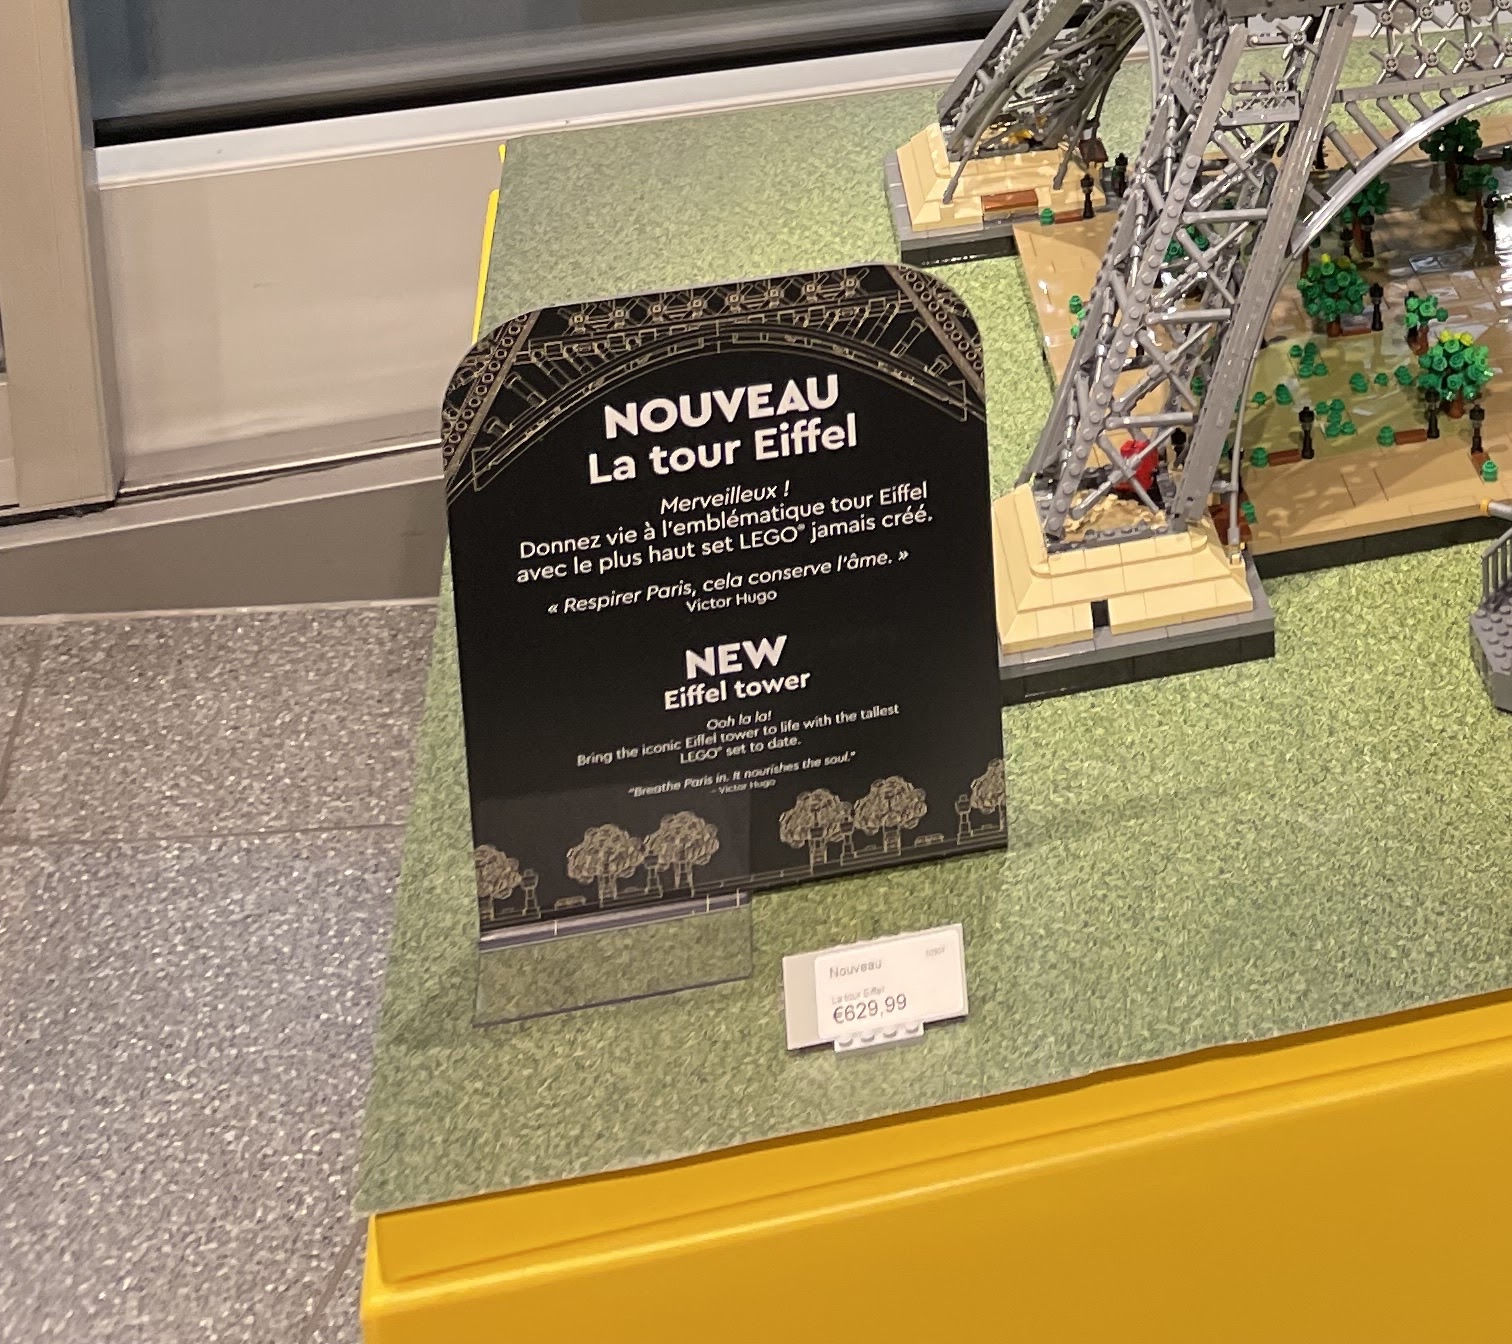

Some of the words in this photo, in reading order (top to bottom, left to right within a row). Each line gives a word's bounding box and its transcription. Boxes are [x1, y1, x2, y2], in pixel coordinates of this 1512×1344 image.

[604, 373, 839, 440] NOUVEAU
[588, 453, 637, 485] La
[649, 439, 742, 475] tour
[754, 412, 858, 461] Eiffel
[660, 484, 778, 515] Merveilleux
[520, 534, 601, 559] Donnez
[605, 526, 638, 546] vie
[643, 521, 656, 541] à
[662, 502, 825, 538] l'emblématique
[830, 494, 874, 513] tour
[879, 480, 928, 506] Eiffel
[517, 563, 567, 584] avec
[573, 555, 592, 575] le
[599, 550, 643, 575] plus
[648, 542, 696, 563] haut
[701, 536, 734, 556] set
[809, 513, 876, 544] jamais
[881, 503, 933, 529] créé.
[563, 588, 643, 614] Respirer
[646, 579, 697, 602] Paris,
[702, 570, 743, 593] cela
[748, 560, 832, 586] conserve
[836, 552, 893, 572] l'âme.
[686, 595, 732, 613] Victor
[736, 589, 778, 606] Hugo
[685, 634, 788, 680] NEW
[664, 679, 727, 711] Eiffel
[733, 672, 811, 699] tower
[576, 751, 613, 767] Bring
[616, 746, 639, 761] the
[641, 739, 682, 757] iconic
[685, 732, 717, 749] Eiffel
[720, 727, 760, 743] tower
[763, 724, 778, 736] to
[780, 720, 800, 733] life
[803, 713, 832, 730] with
[835, 711, 858, 724] the
[860, 704, 900, 721] tallest
[706, 714, 736, 731] Ooh
[738, 713, 751, 726] la
[754, 710, 772, 724] la!
[726, 744, 746, 757] set
[750, 741, 764, 753] to
[767, 736, 802, 750] date.
[684, 775, 713, 789] Paris
[743, 762, 800, 779] nourishes
[802, 757, 822, 771] the
[718, 782, 747, 795] Victor
[829, 959, 883, 980] Nouveau
[833, 992, 908, 1024] €629,99
